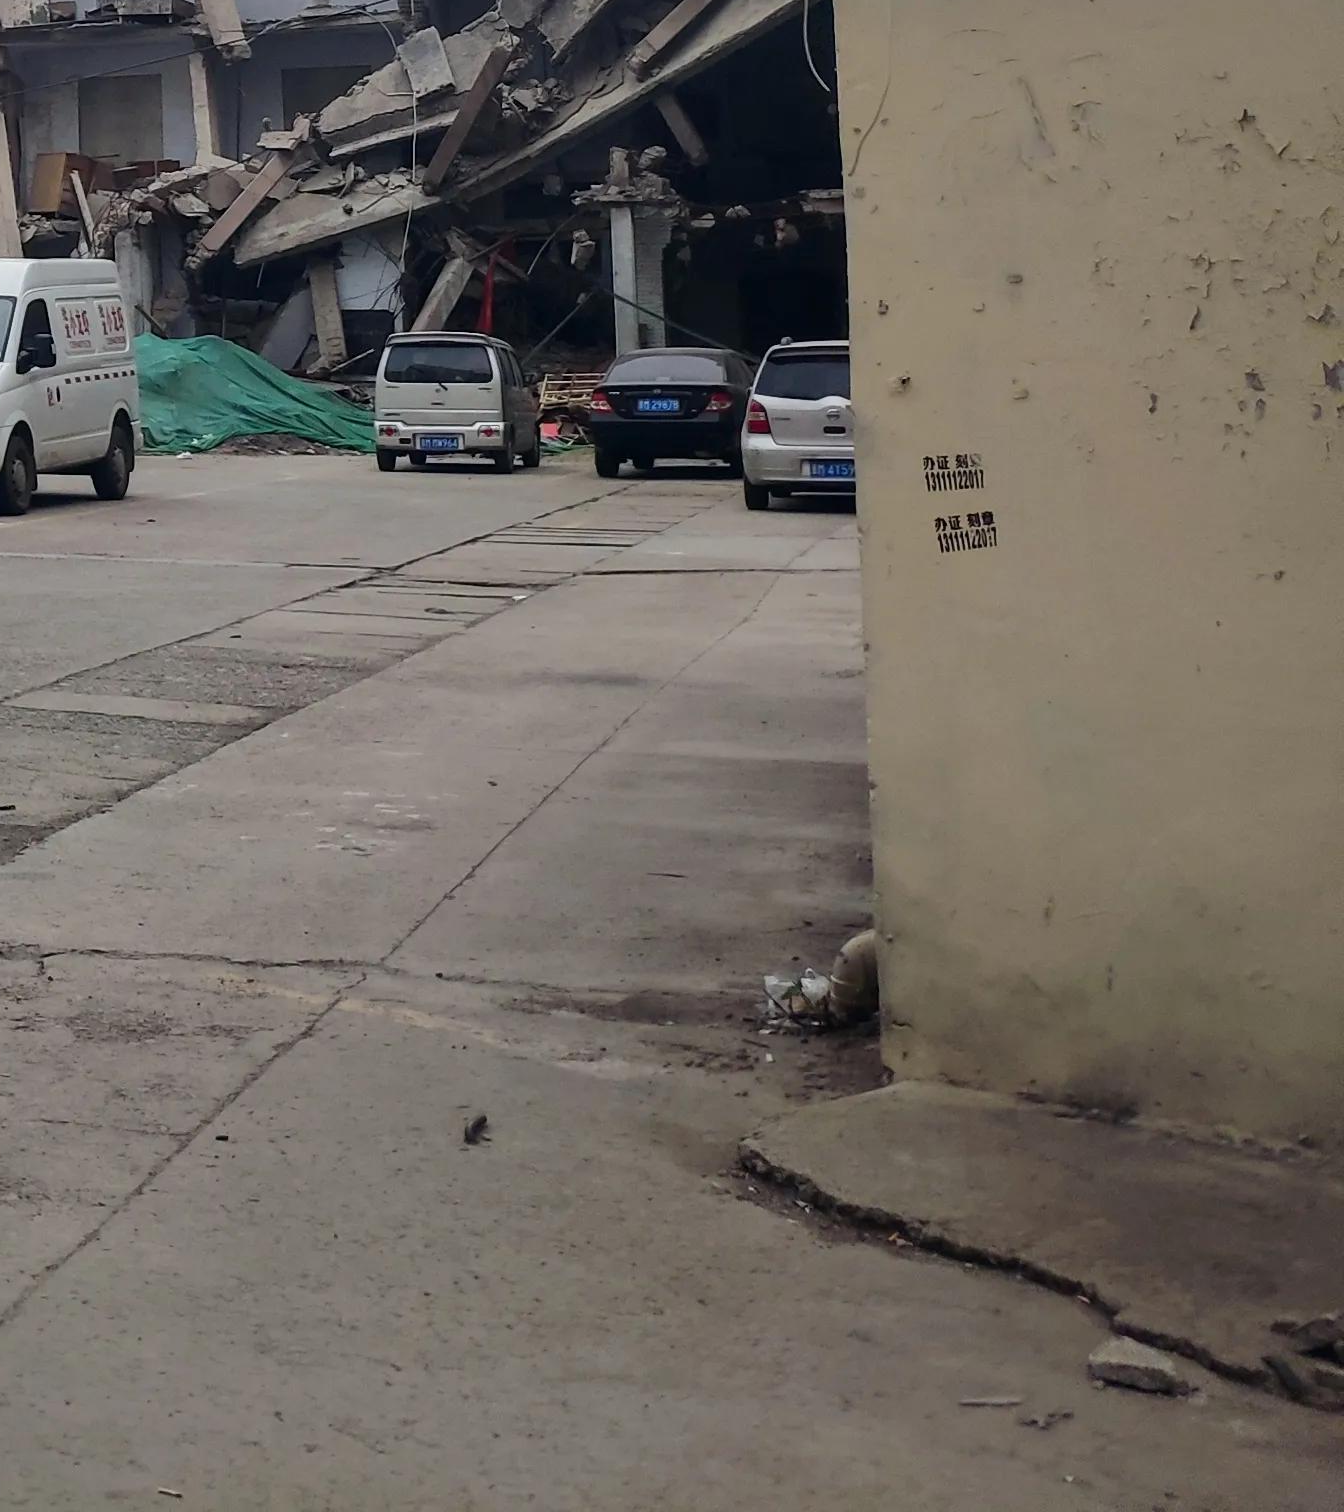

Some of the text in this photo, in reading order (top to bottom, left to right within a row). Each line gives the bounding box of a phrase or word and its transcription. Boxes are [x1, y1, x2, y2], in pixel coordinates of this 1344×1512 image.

[922, 455, 951, 471] 办证
[925, 469, 985, 492] 13111122017
[934, 510, 996, 533] 办证 刻章
